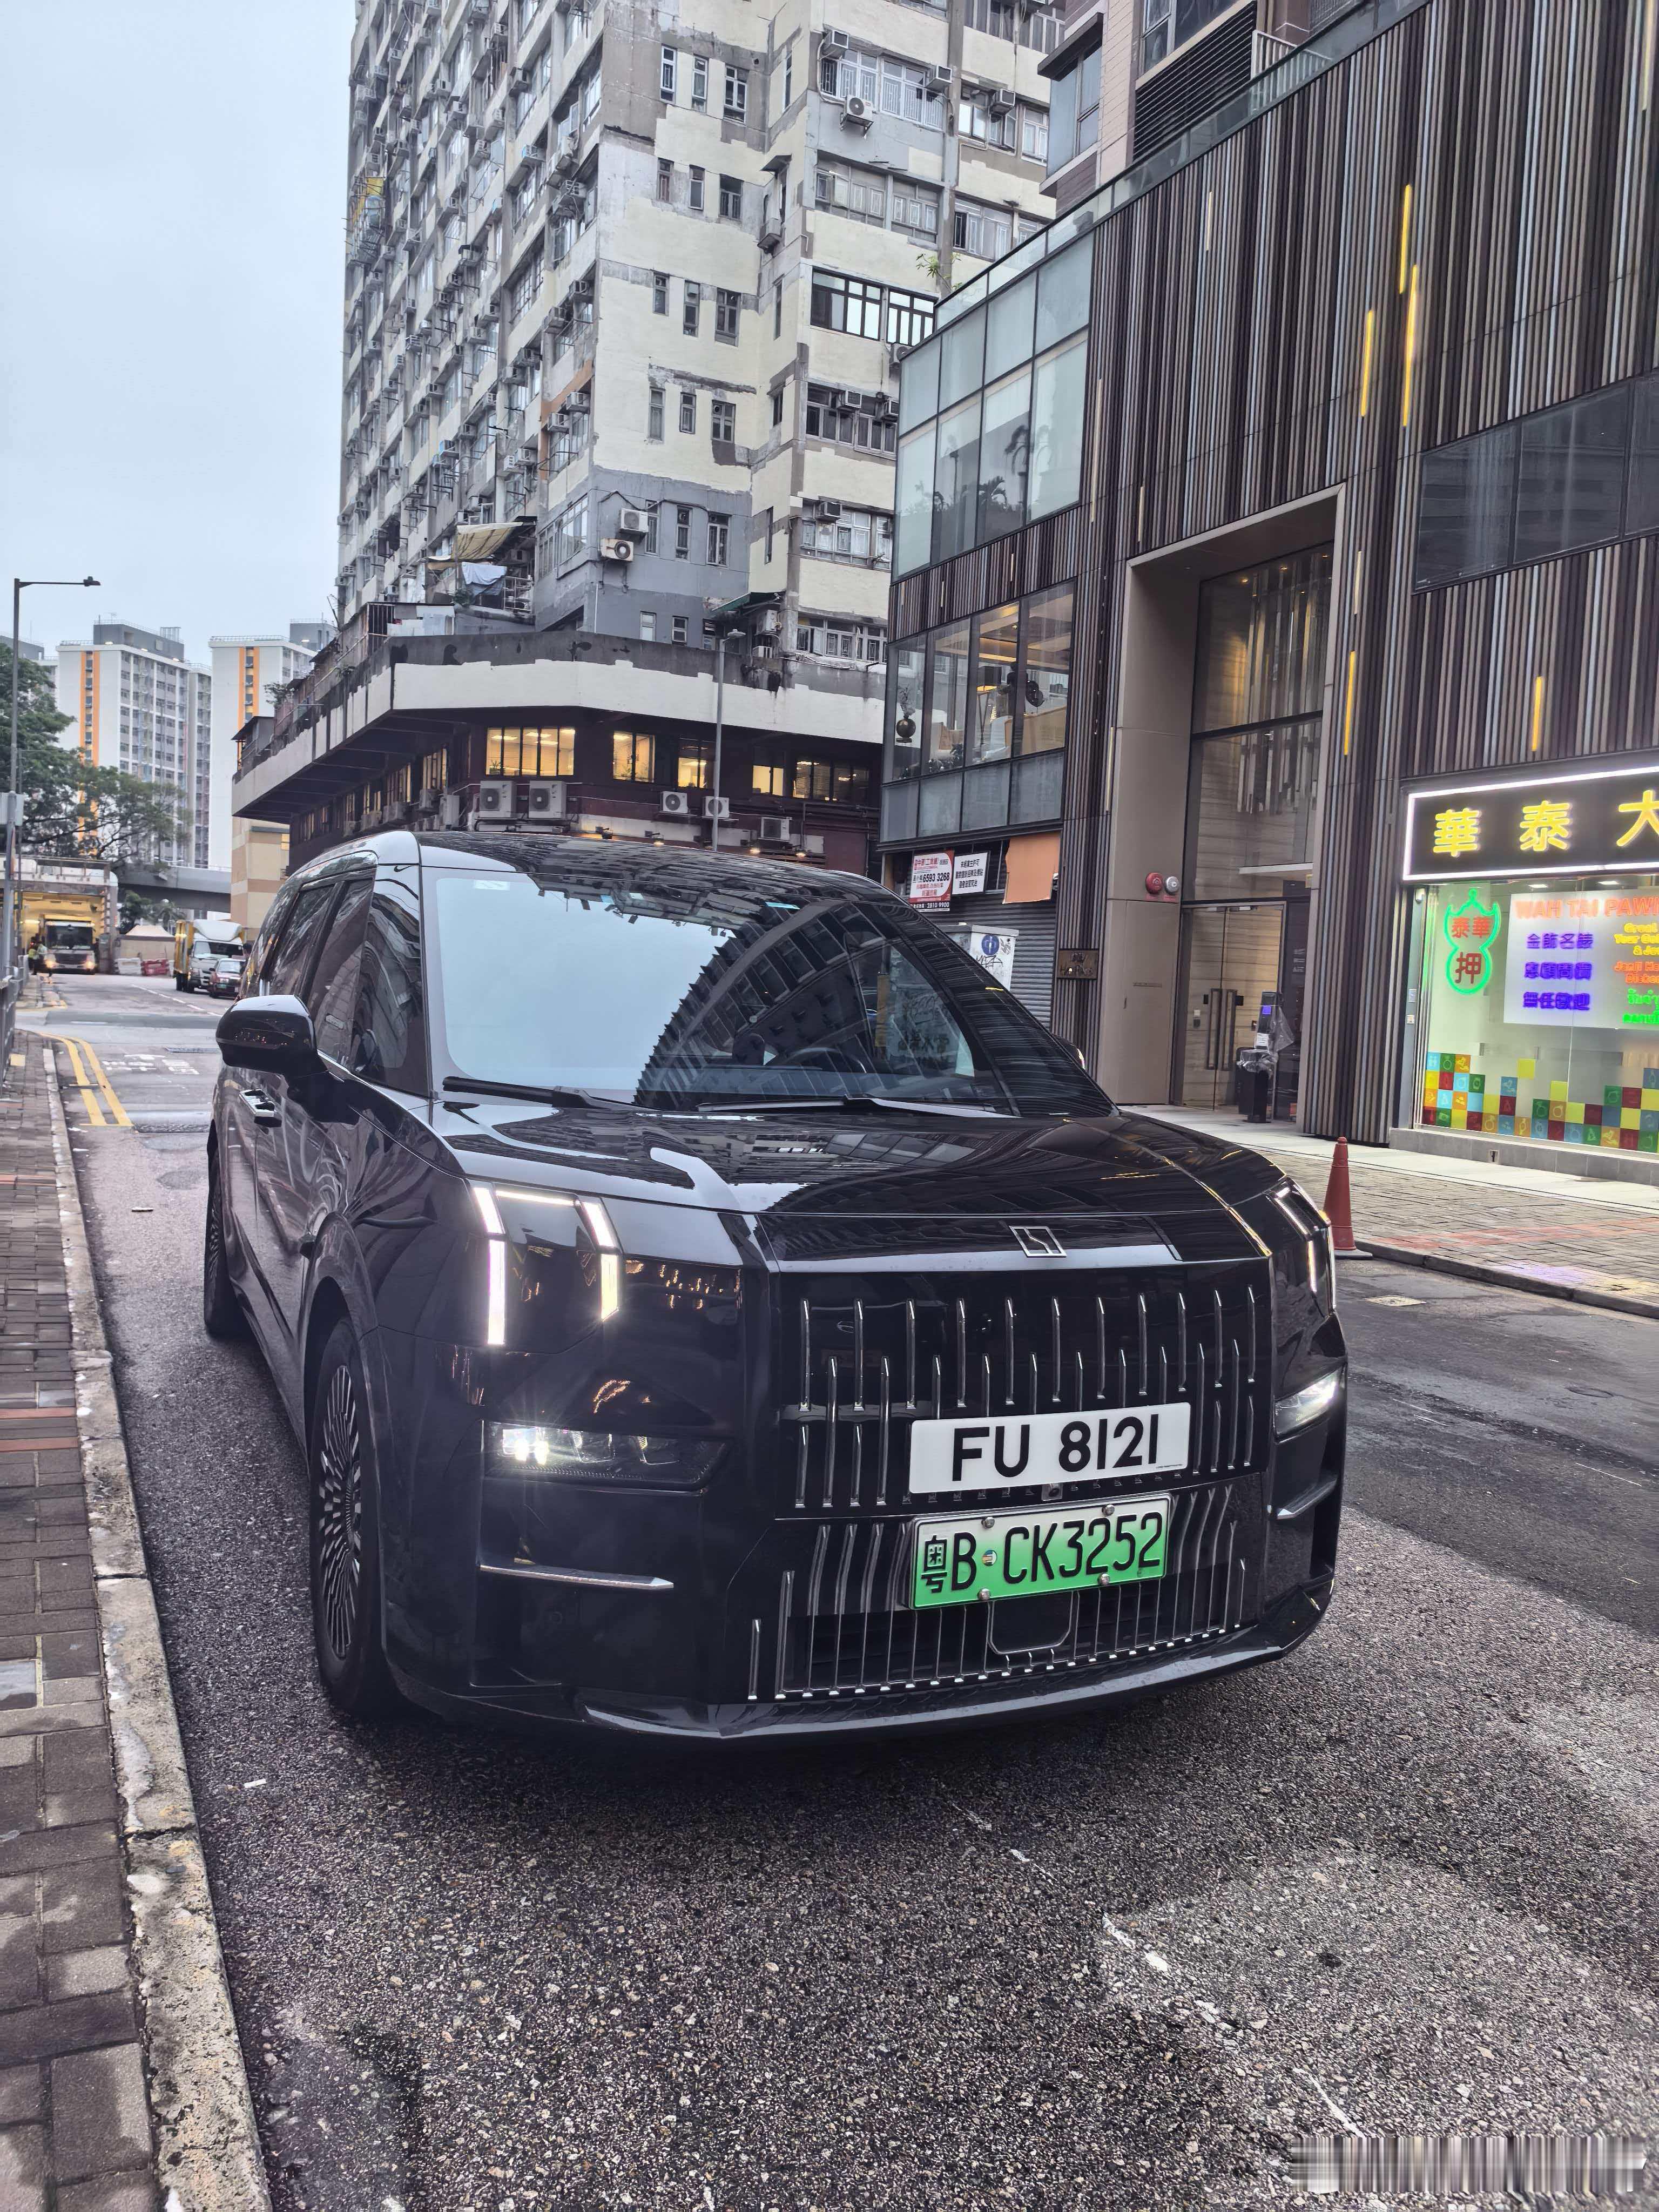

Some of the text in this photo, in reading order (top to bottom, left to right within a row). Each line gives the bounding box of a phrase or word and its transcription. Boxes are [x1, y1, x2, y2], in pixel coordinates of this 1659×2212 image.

[923, 873, 936, 882] 6593
[1515, 899, 1562, 918] WAH
[1568, 898, 1599, 917] TAI
[1455, 952, 1482, 984] 押
[952, 1413, 1159, 1482] FU 8121
[1003, 1512, 1163, 1584] CK3252
